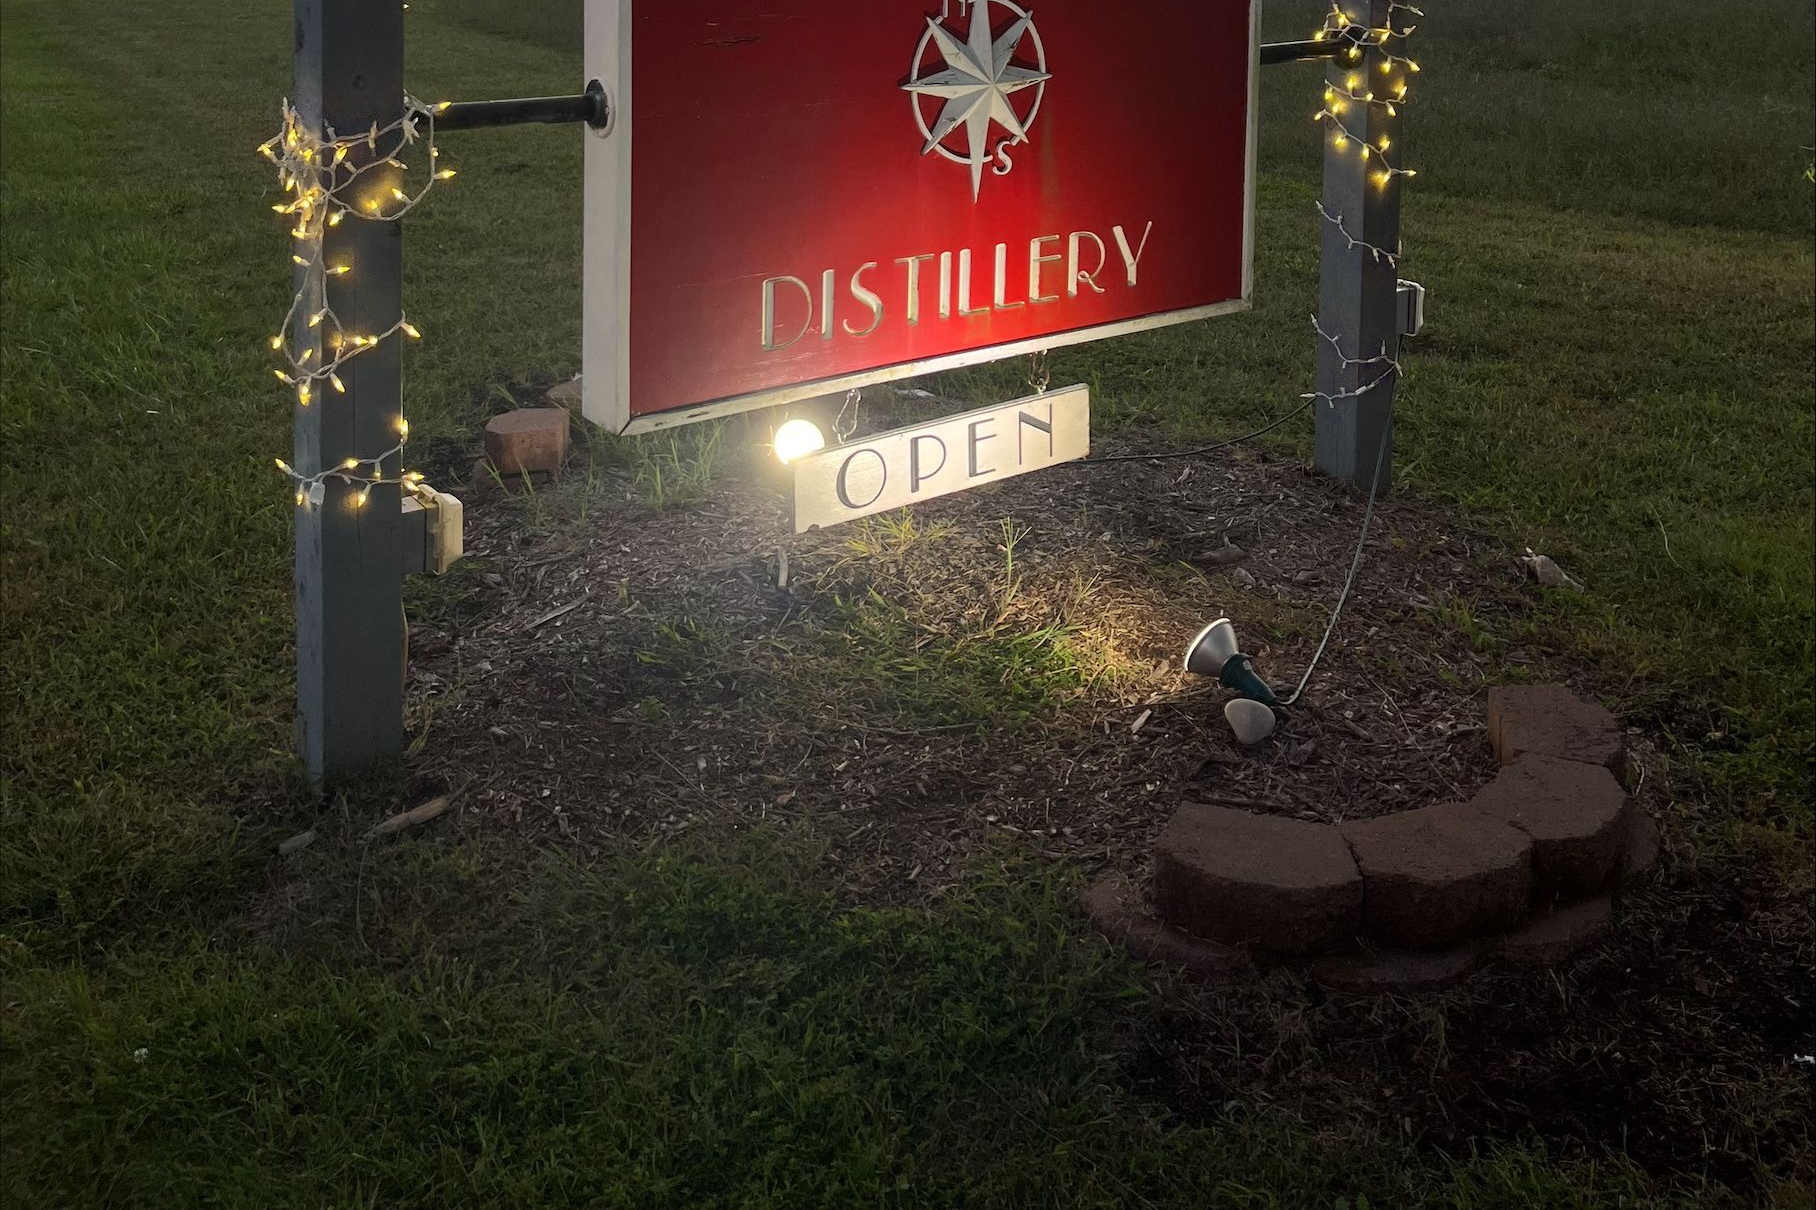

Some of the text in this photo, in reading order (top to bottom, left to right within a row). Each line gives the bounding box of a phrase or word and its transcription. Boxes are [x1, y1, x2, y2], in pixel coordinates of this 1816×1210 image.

[991, 140, 1014, 176] S
[761, 220, 1154, 352] DISTILLERY
[835, 402, 1054, 510] OPEN
